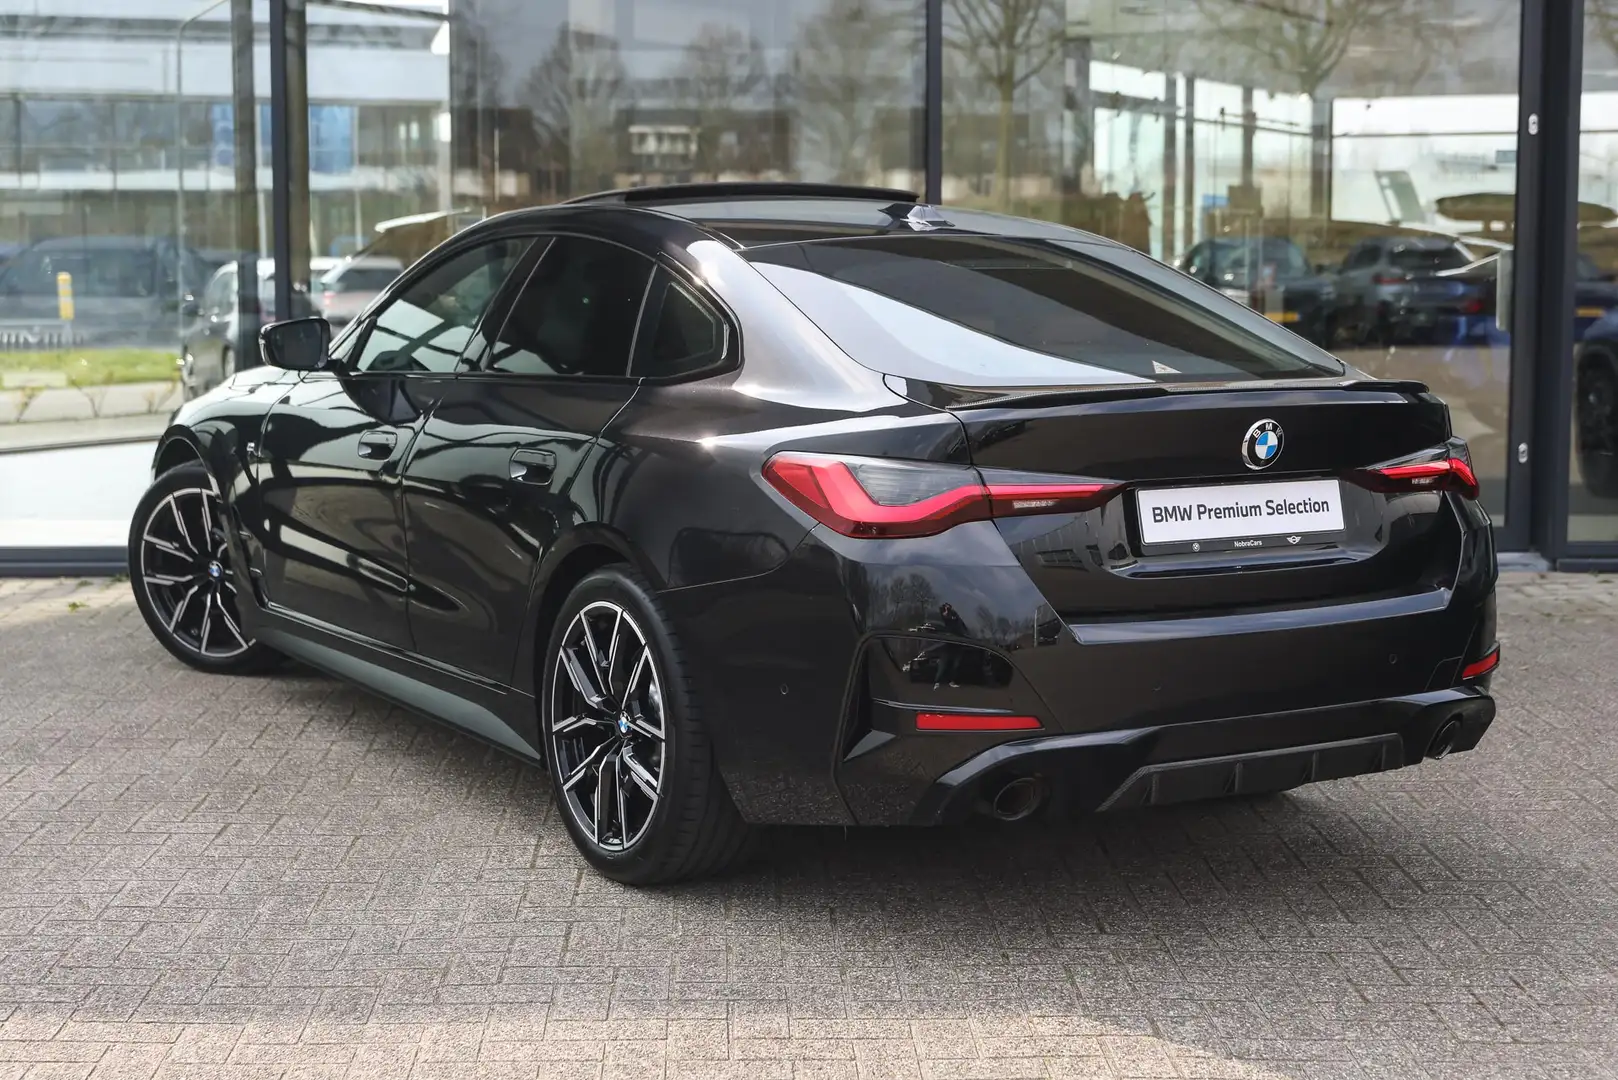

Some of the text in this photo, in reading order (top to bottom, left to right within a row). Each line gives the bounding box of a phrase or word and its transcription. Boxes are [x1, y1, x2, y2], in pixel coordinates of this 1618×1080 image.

[1252, 422, 1283, 438] BMW
[1152, 498, 1330, 523] BMW Premium Selection
